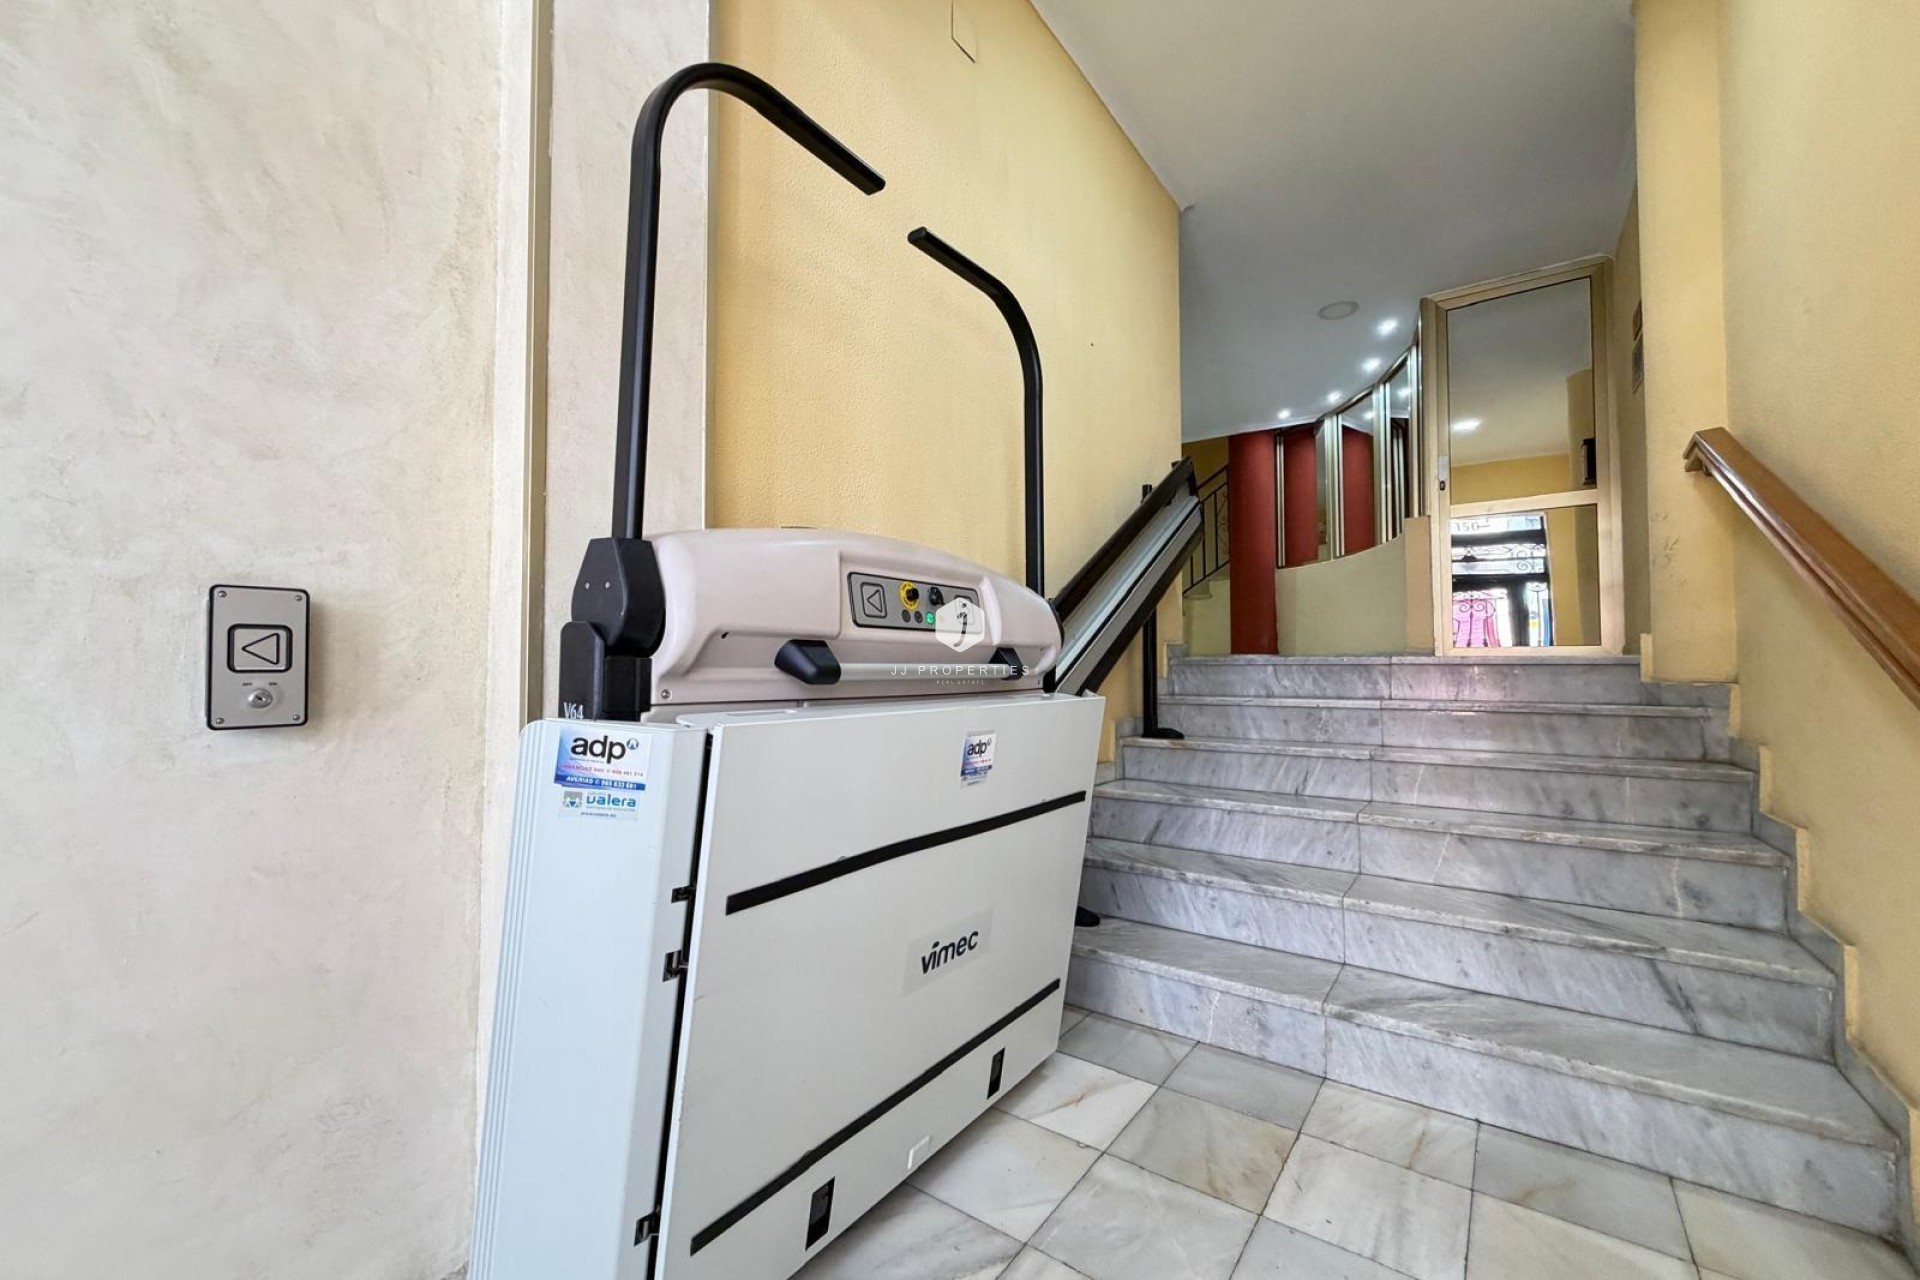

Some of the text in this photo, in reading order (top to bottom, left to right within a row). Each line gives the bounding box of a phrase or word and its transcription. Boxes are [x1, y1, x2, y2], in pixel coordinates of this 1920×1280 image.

[563, 701, 584, 720] V64
[570, 735, 627, 764] adp
[967, 739, 988, 758] adp
[921, 930, 979, 974] vimec
